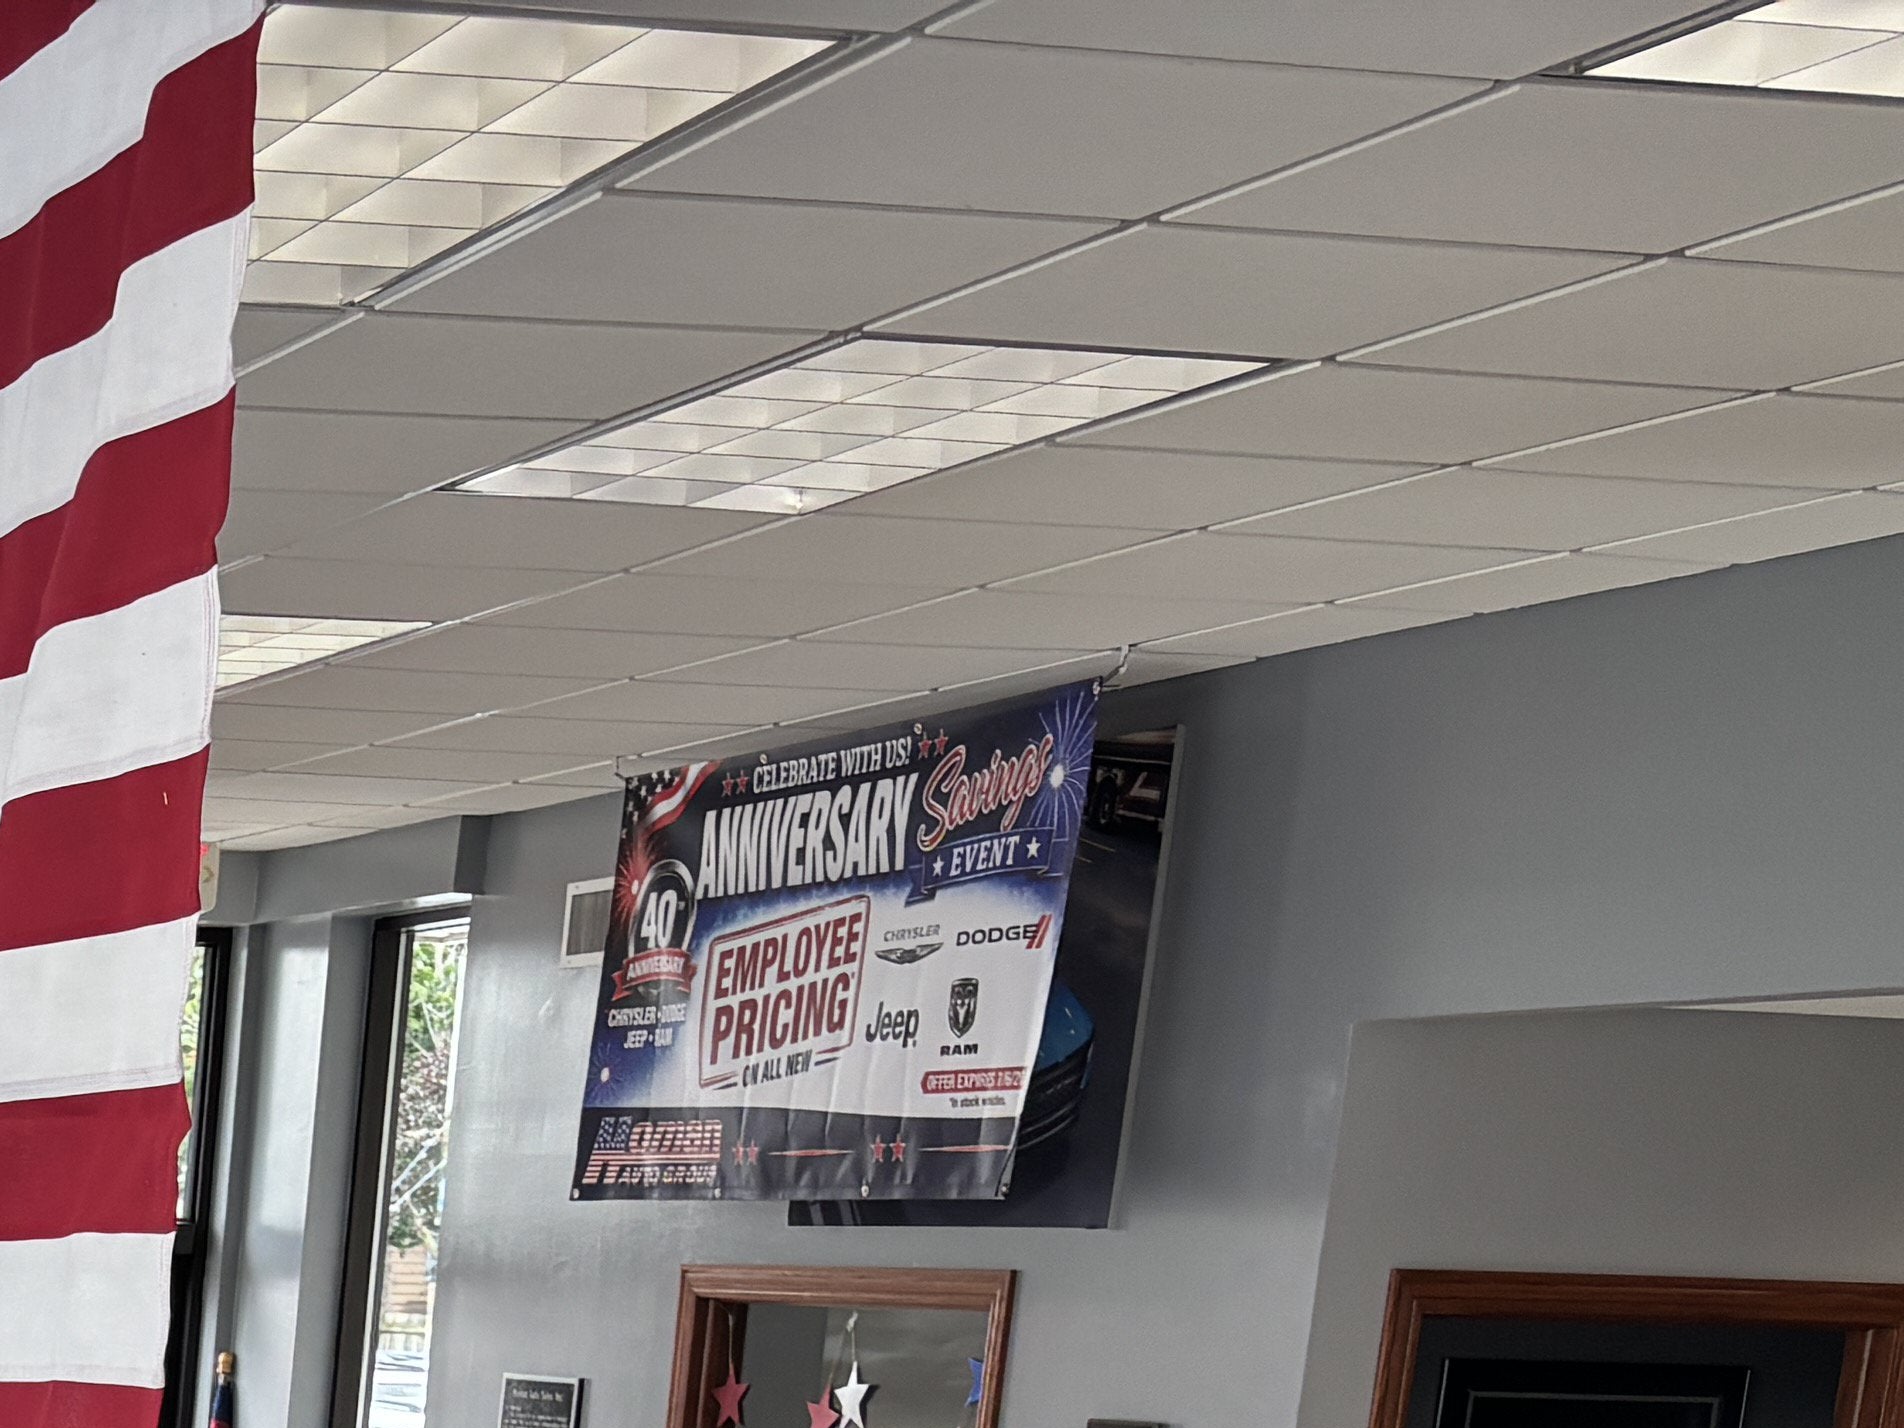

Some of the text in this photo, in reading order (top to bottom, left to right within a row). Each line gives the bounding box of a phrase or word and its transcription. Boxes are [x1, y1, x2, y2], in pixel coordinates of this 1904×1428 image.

[753, 736, 913, 794] CELEBRATE WITH US!
[916, 733, 1054, 852] Savings
[695, 773, 918, 901] ANNIVERSARY
[949, 835, 1020, 878] EVENT
[713, 912, 862, 1001] EMPLOYEE
[883, 924, 940, 942] CHRYSLER
[956, 923, 1039, 946] DODGE
[709, 972, 850, 1065] PRICING
[865, 1001, 919, 1048] Jeep
[742, 1049, 813, 1088] ON ALL NEW
[940, 1043, 979, 1057] RAM
